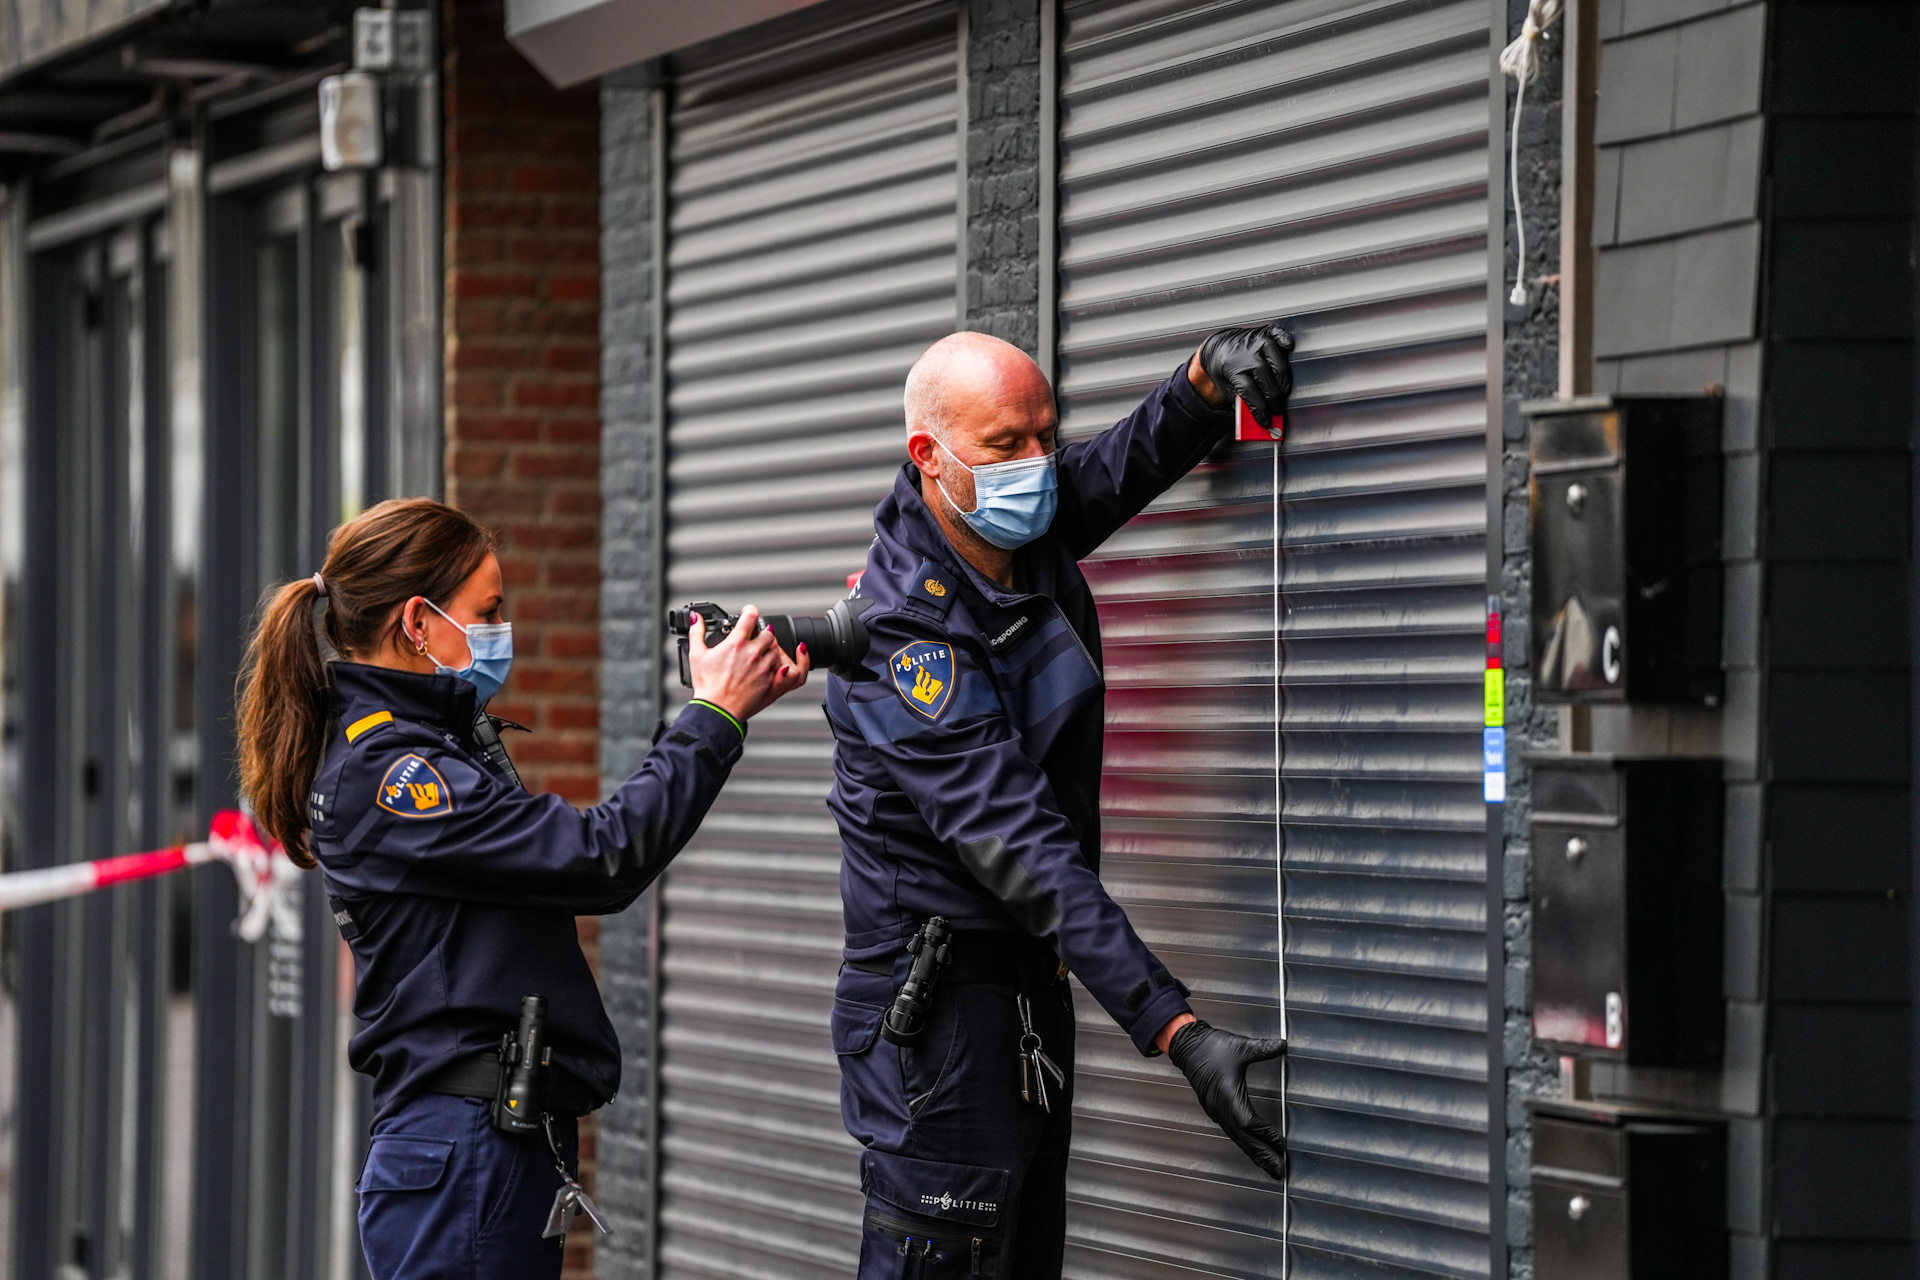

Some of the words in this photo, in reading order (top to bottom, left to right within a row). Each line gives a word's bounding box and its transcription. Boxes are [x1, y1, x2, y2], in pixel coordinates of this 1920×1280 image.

[895, 650, 946, 672] POLITIE
[1603, 625, 1620, 684] C
[385, 760, 419, 805] POLITIE
[933, 1194, 984, 1212] POLITIE
